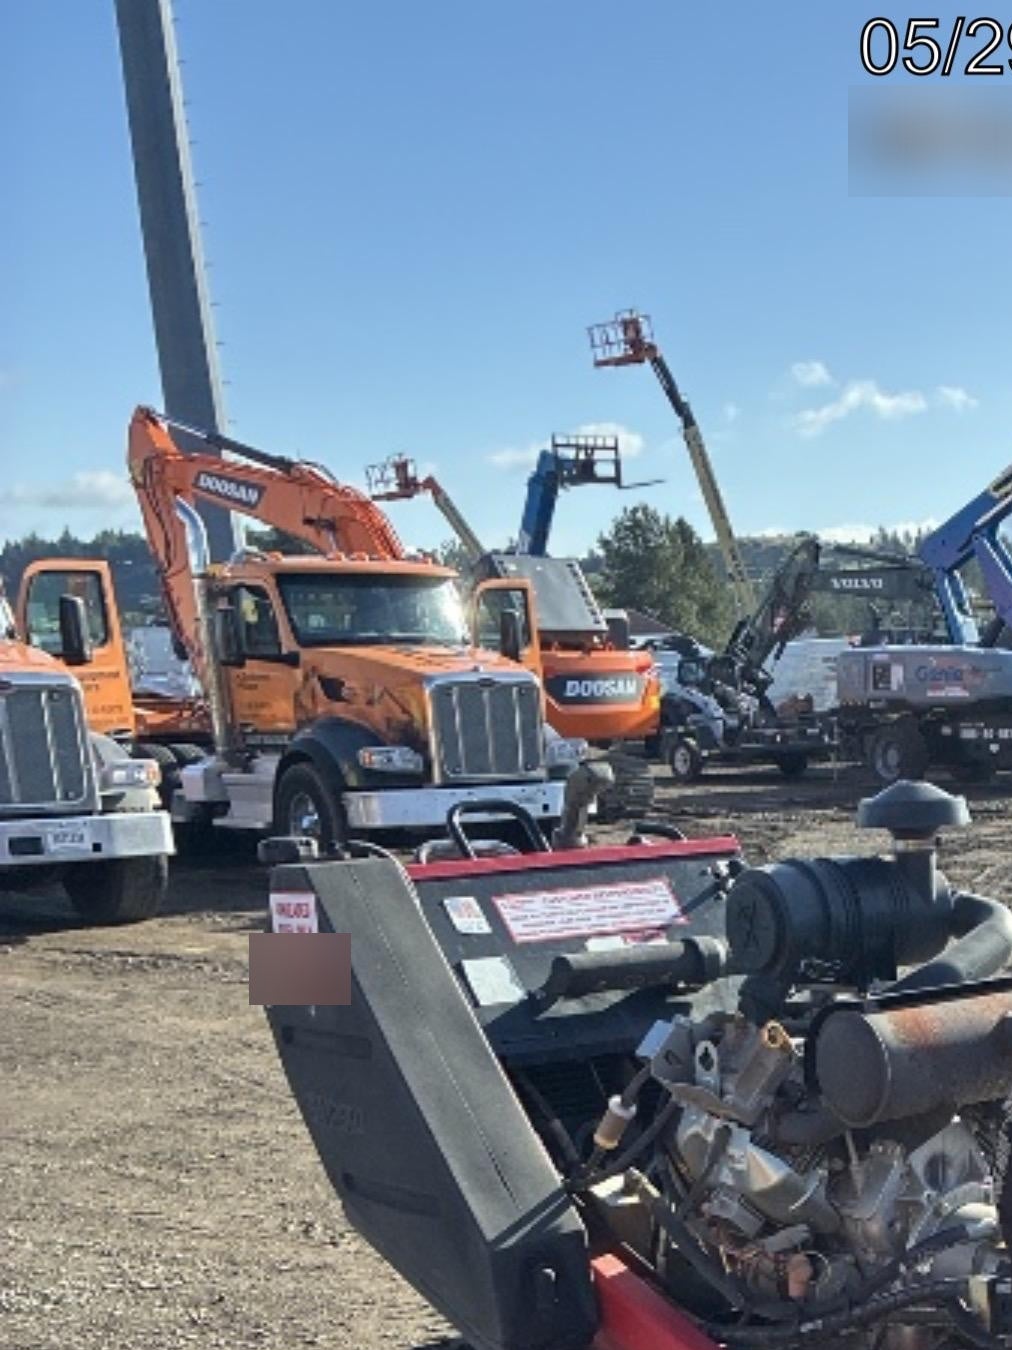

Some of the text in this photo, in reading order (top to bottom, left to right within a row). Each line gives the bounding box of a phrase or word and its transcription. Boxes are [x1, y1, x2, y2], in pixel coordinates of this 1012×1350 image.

[197, 473, 259, 504] DOOSAN
[831, 578, 883, 589] VOLVO
[563, 678, 637, 697] DOOSAN
